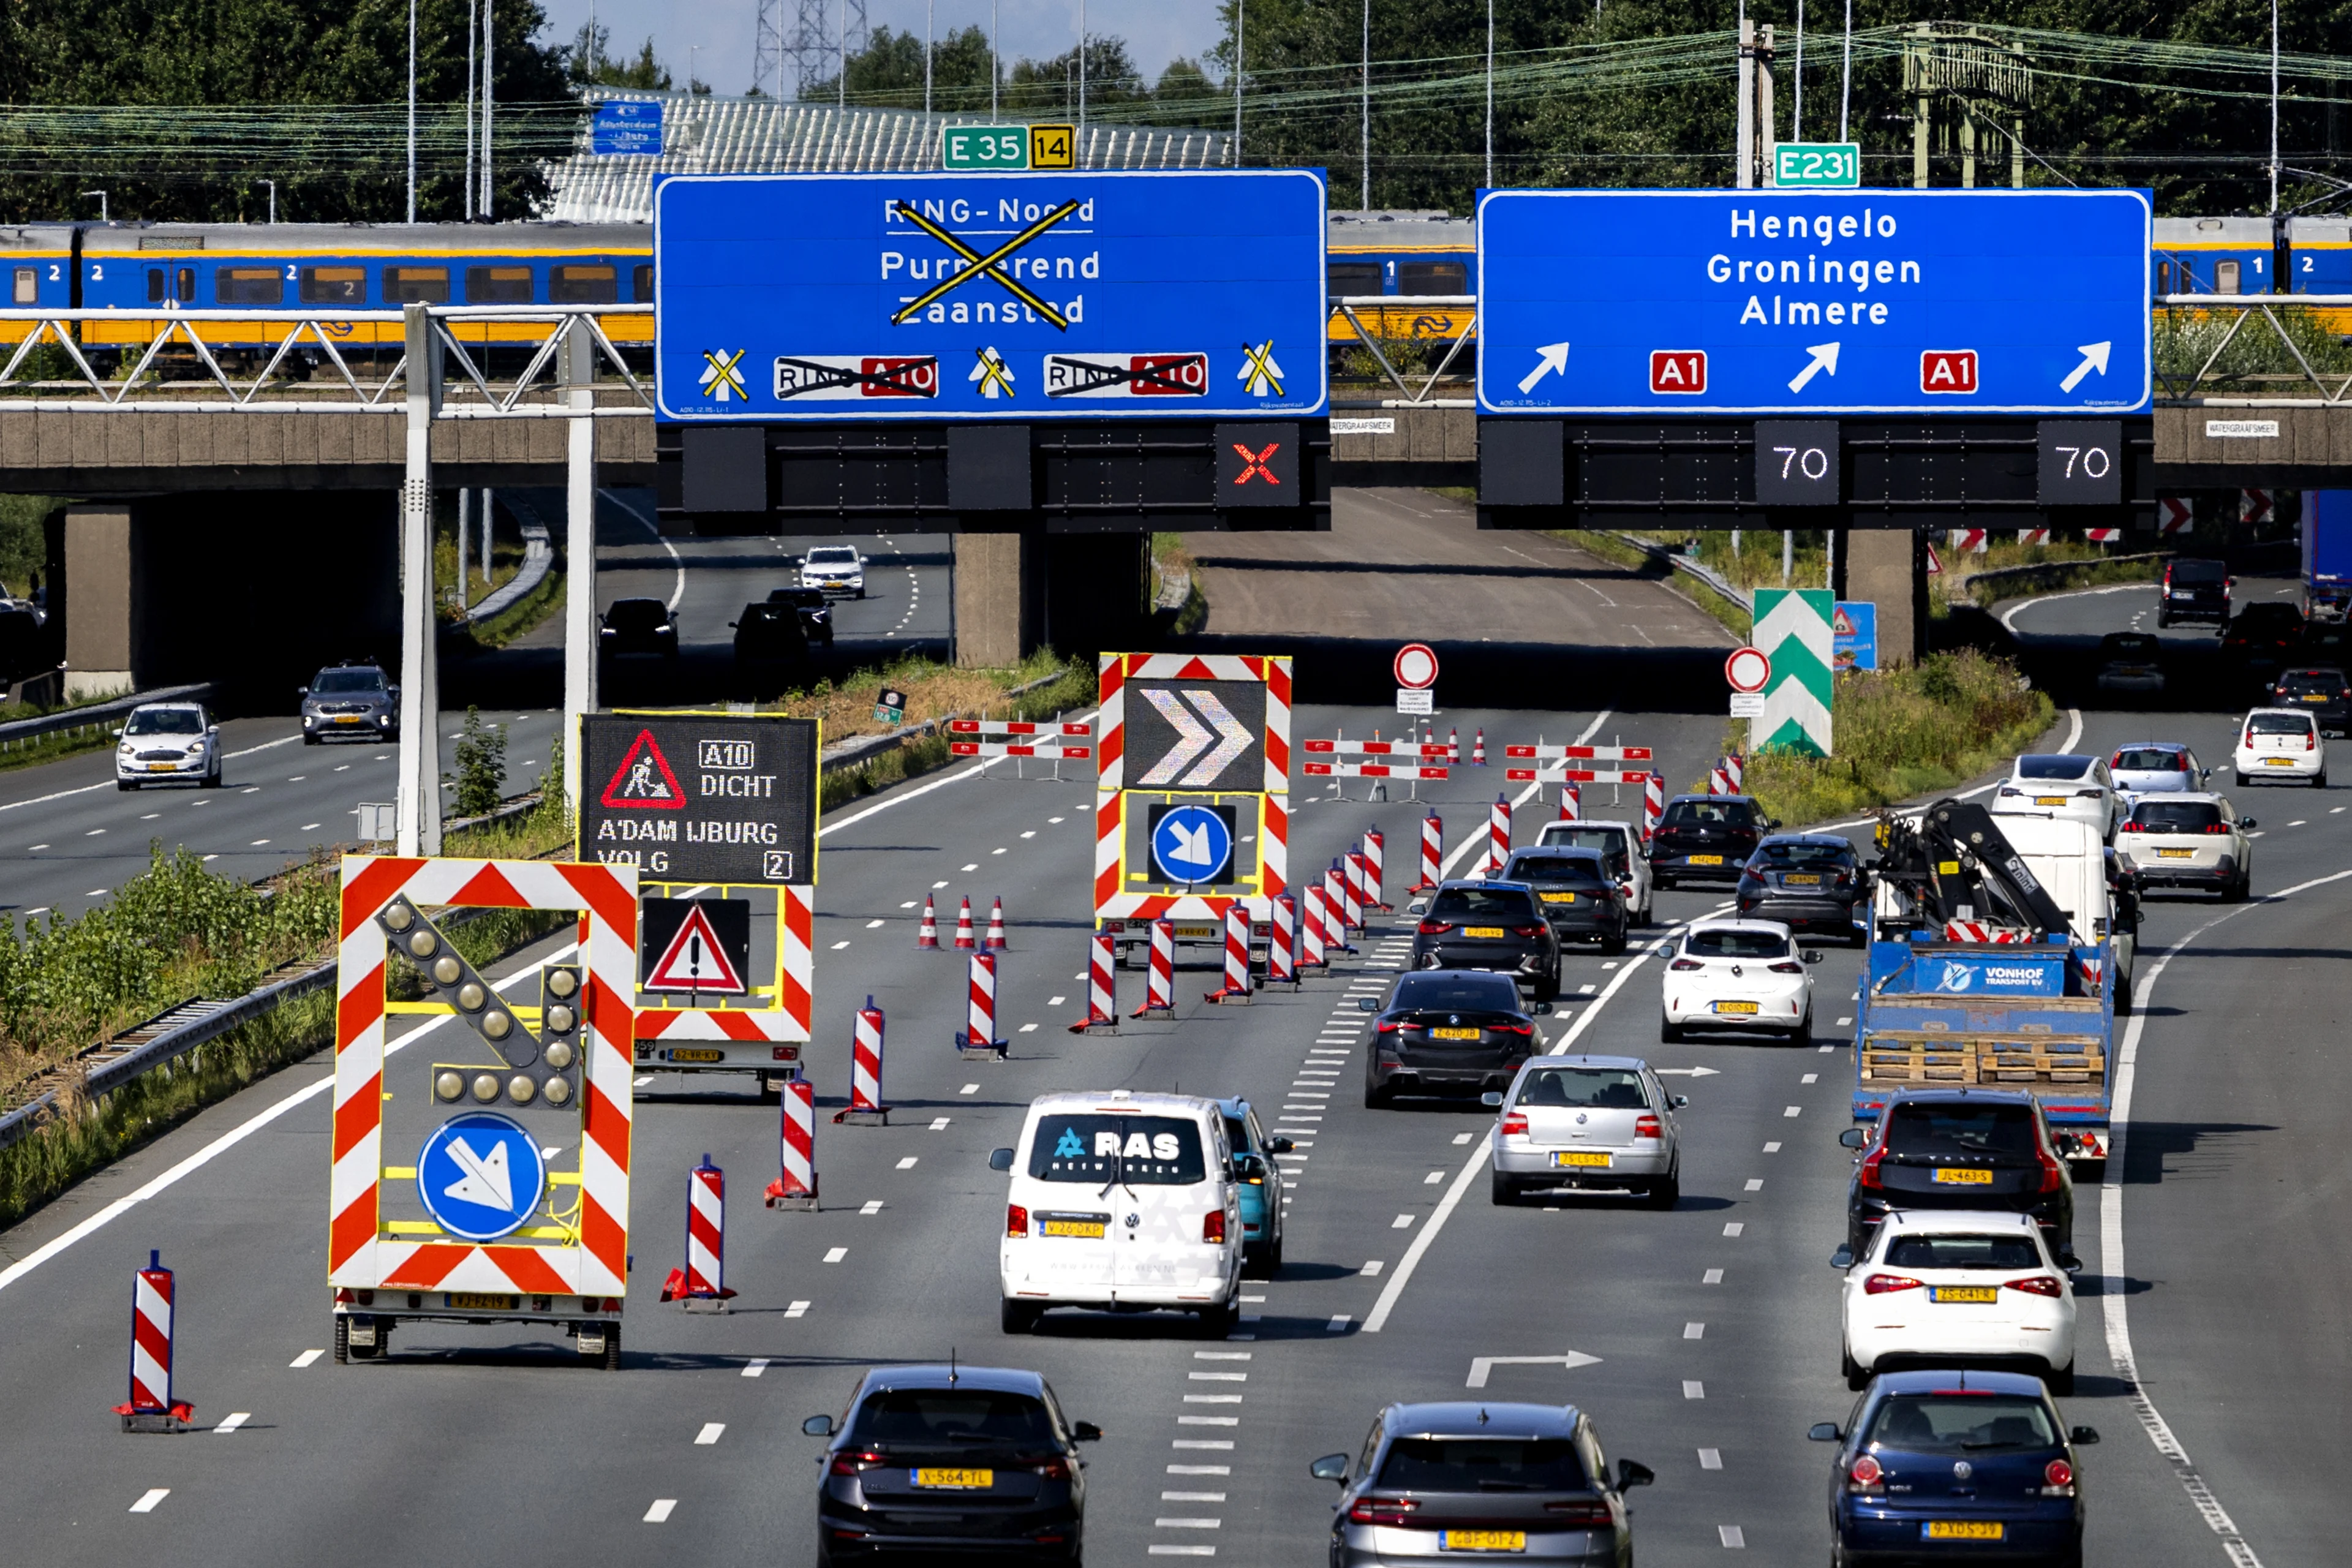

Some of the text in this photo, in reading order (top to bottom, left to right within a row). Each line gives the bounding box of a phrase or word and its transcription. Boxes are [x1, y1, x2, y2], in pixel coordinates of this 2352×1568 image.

[952, 135, 1020, 160] E 35
[1036, 137, 1067, 158] 14
[1780, 152, 1853, 179] E231
[1731, 208, 1897, 246] Hengelo
[49, 265, 60, 281] 2
[92, 265, 103, 281] 2
[287, 265, 297, 281] 2
[1387, 261, 1395, 276] 1
[1707, 254, 1921, 292] Groningen
[2253, 257, 2263, 273] 1
[2302, 257, 2314, 273] 2
[344, 282, 354, 296] 2
[1740, 295, 1888, 325] Almere
[780, 363, 933, 389] RIN A10
[1050, 361, 1203, 388] RIN A10
[1659, 358, 1698, 385] A1
[1929, 358, 1970, 385] A1
[1330, 421, 1392, 431] ATERGRAAFSMEER
[1773, 447, 1828, 480] 70
[2056, 447, 2110, 478] 70
[704, 744, 748, 765] A10
[701, 775, 777, 797] DICHT
[597, 820, 677, 841] A'DAM
[598, 850, 783, 875] VOLG 2
[1985, 967, 2044, 978] VONHOF
[1095, 1131, 1180, 1160] RAS
